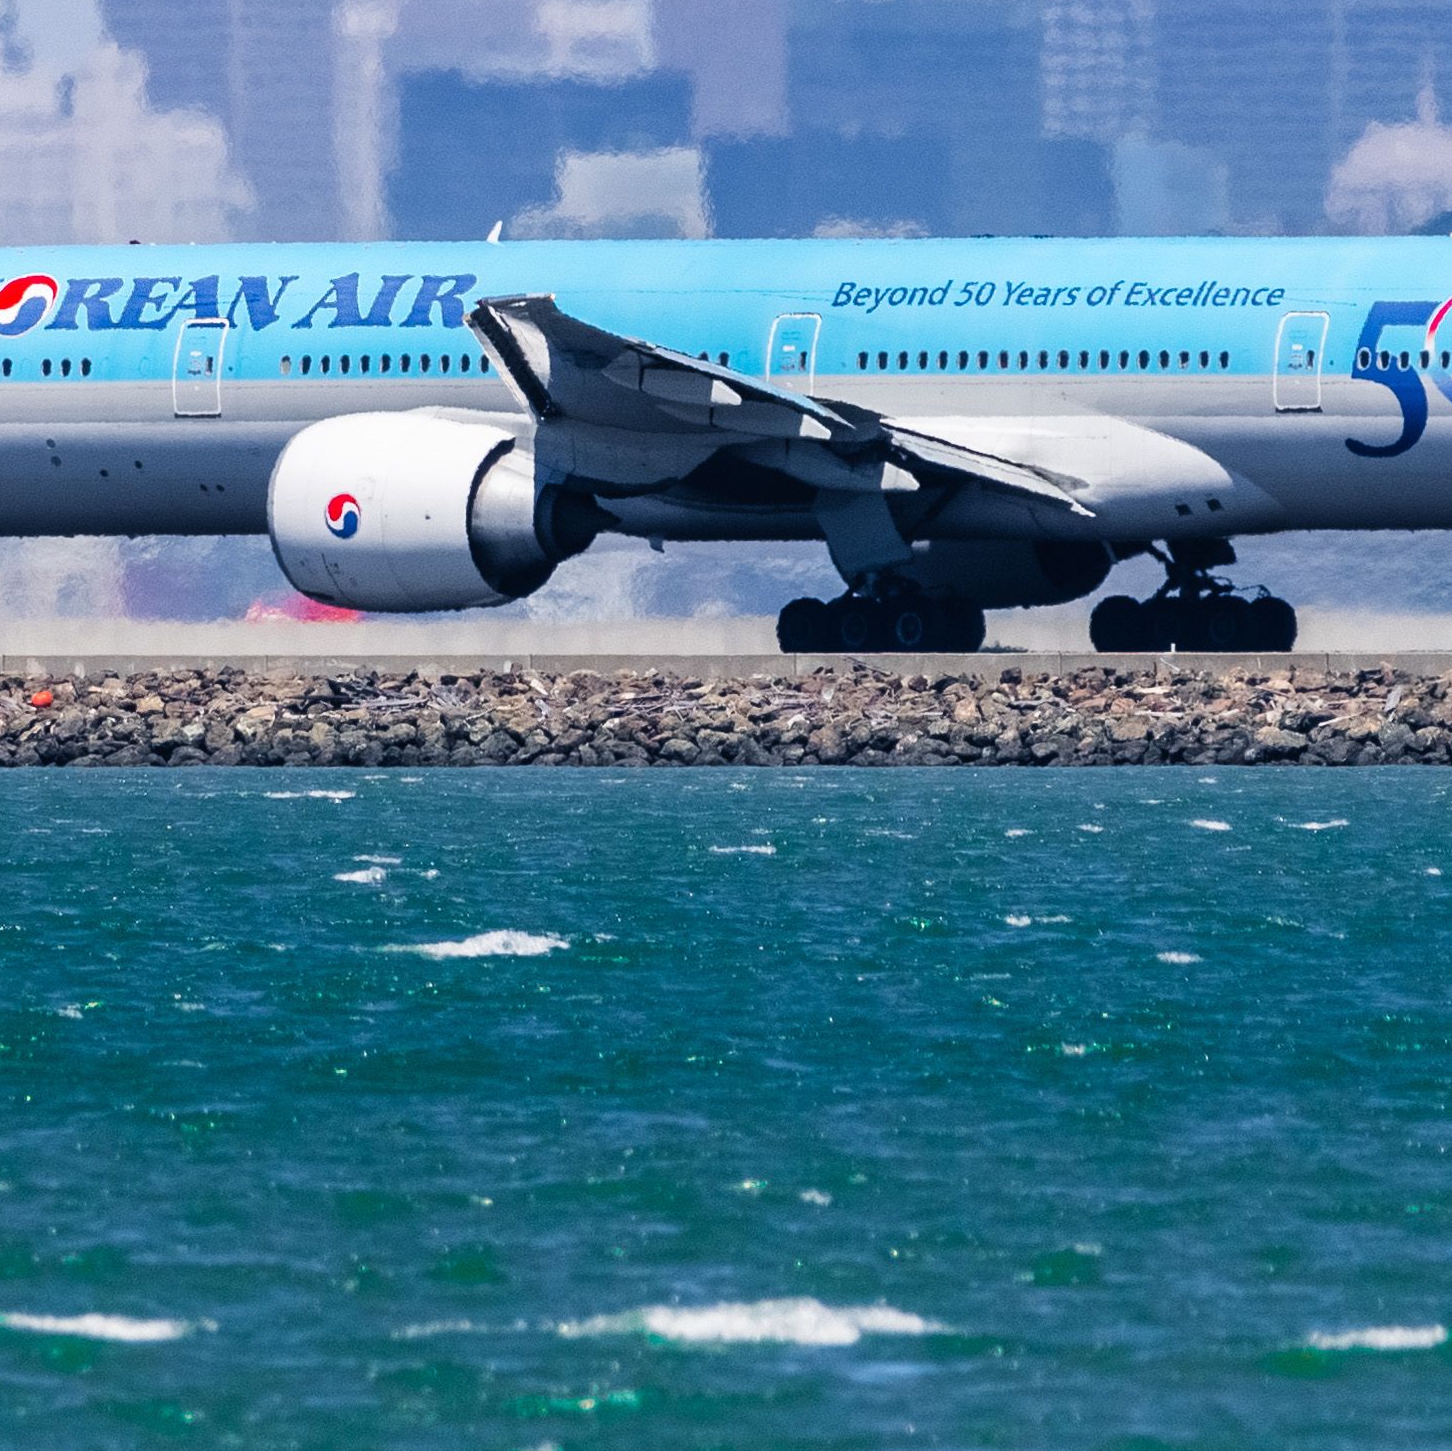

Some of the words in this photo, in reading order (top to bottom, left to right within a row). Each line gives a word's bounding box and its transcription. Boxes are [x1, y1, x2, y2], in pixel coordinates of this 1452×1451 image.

[291, 272, 478, 330] AIR
[830, 279, 954, 314] Beyond
[953, 281, 997, 307] 50
[1002, 281, 1082, 307] Years
[1085, 279, 1125, 307] of
[1123, 279, 1286, 307] Excellence
